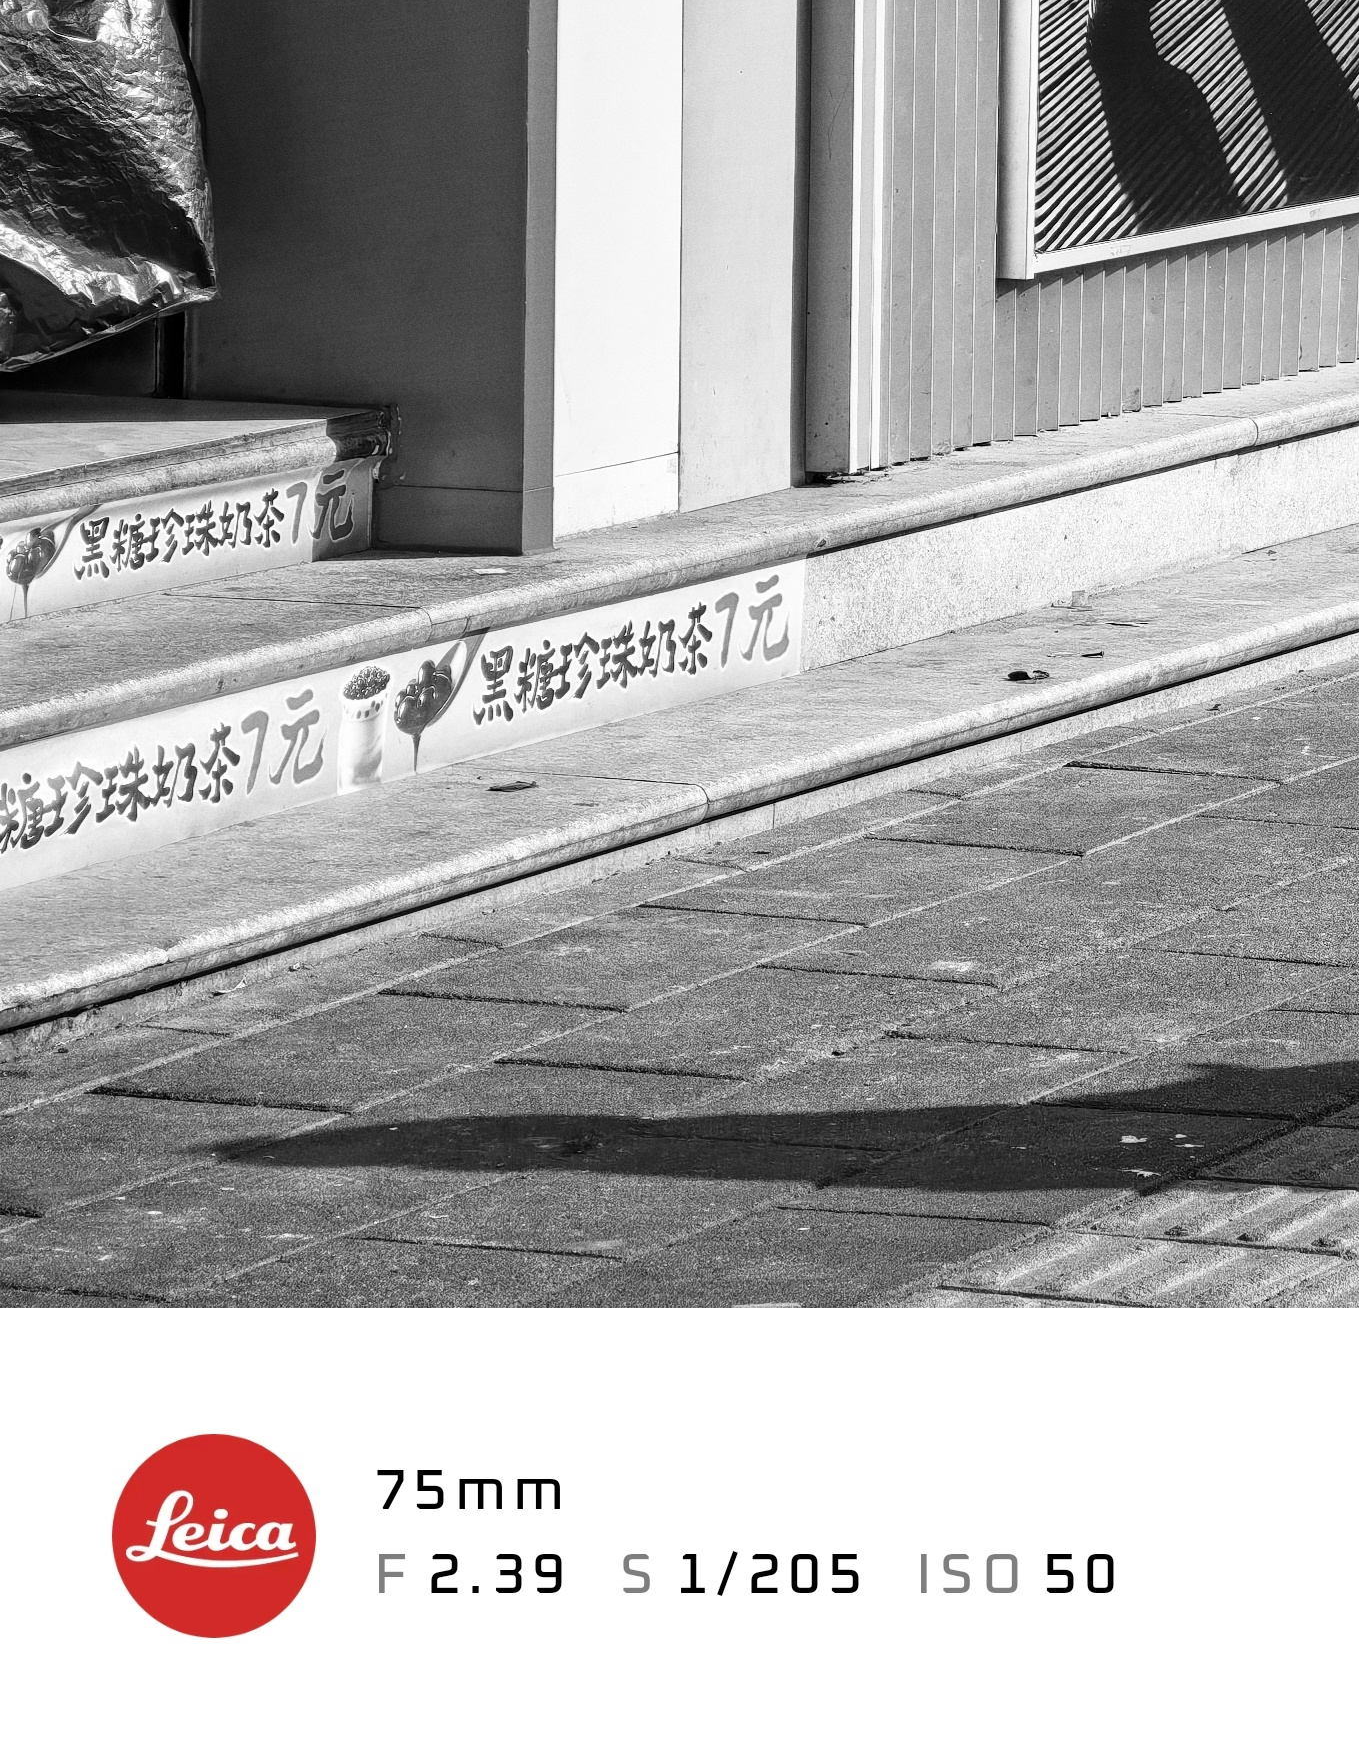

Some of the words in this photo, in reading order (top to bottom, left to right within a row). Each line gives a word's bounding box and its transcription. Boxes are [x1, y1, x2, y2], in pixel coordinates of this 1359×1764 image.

[74, 468, 355, 582] 黑糖珍珠奶茶7元
[472, 574, 791, 725] 黑糖珍珠奶茶7元
